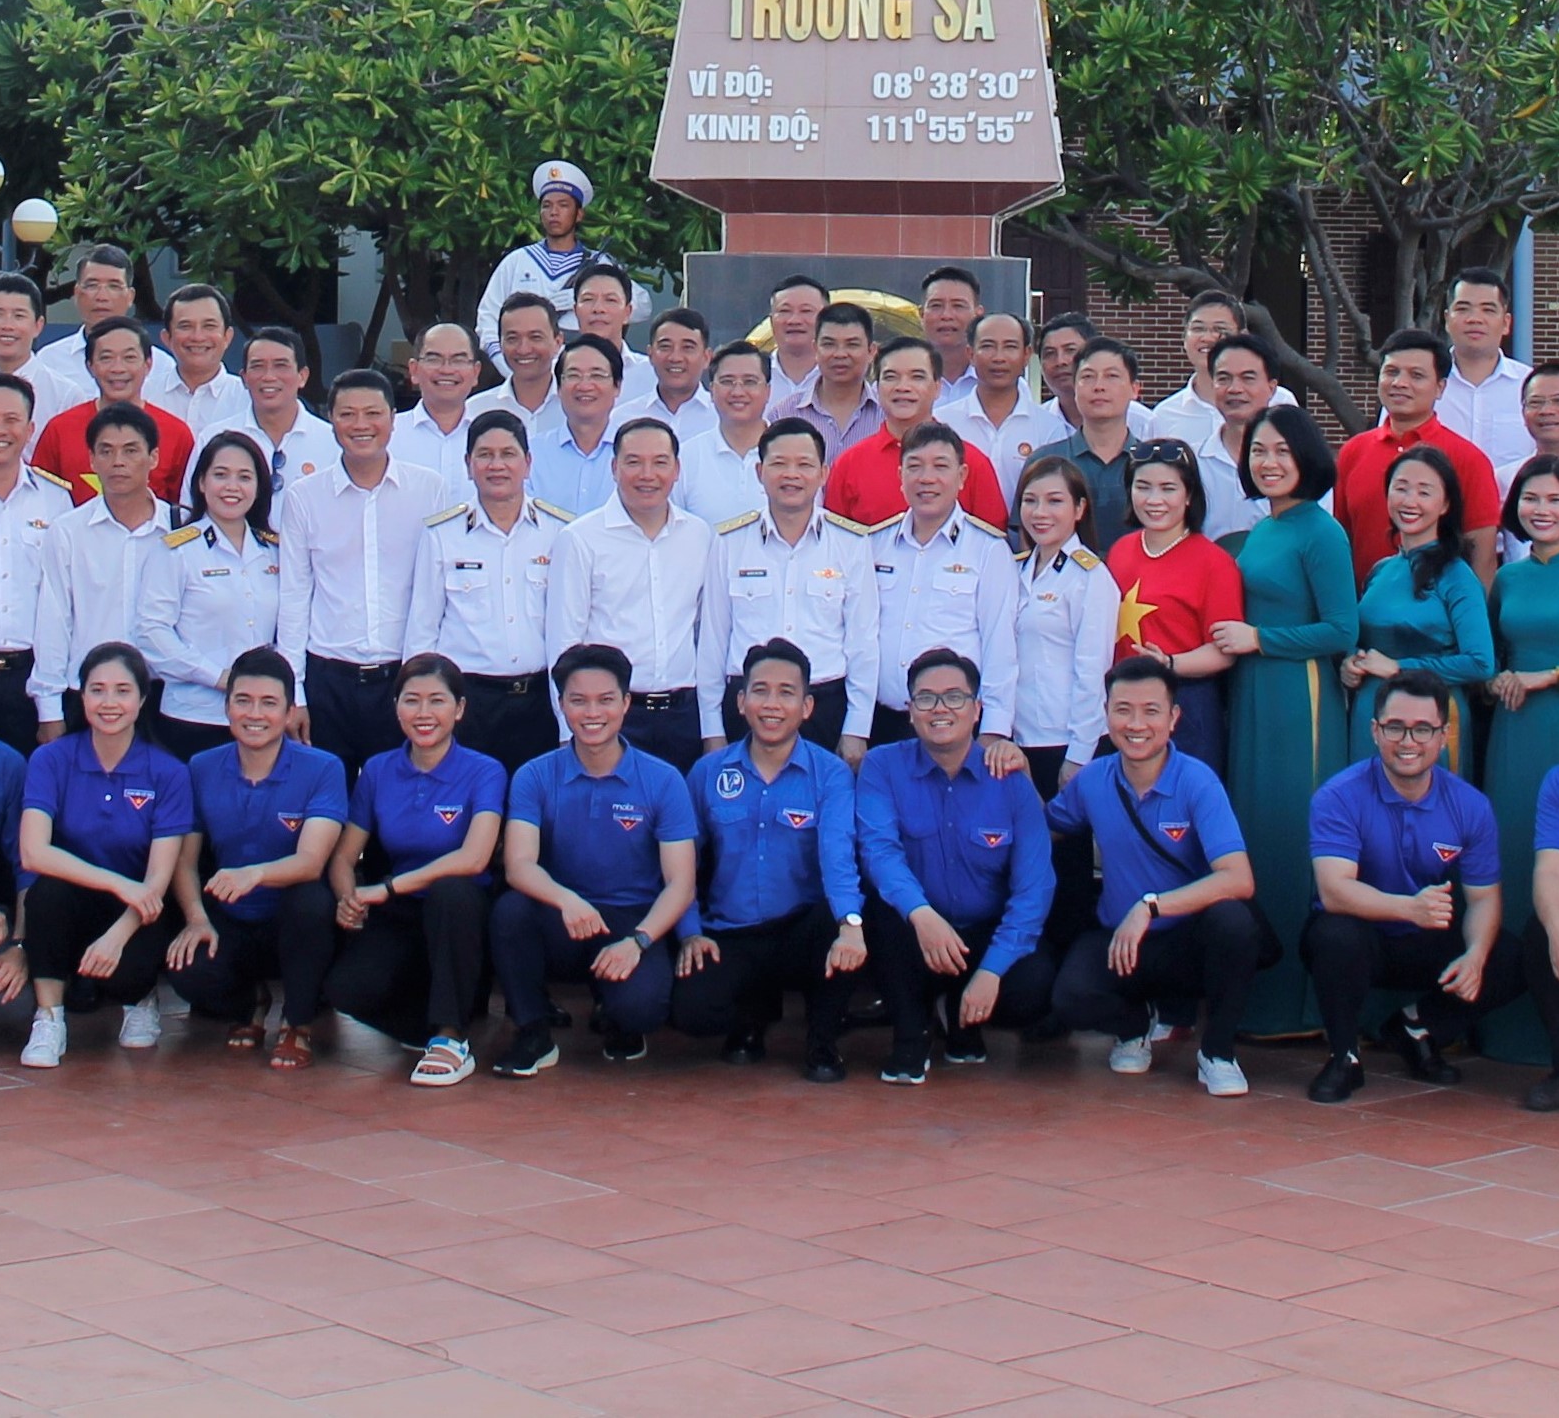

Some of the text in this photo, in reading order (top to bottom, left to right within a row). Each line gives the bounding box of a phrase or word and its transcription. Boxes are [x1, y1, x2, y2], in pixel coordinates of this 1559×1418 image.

[688, 62, 720, 98] VĨ
[724, 63, 773, 104] ĐỘ:
[687, 113, 761, 142] KINH
[768, 107, 820, 151] ĐỘ:
